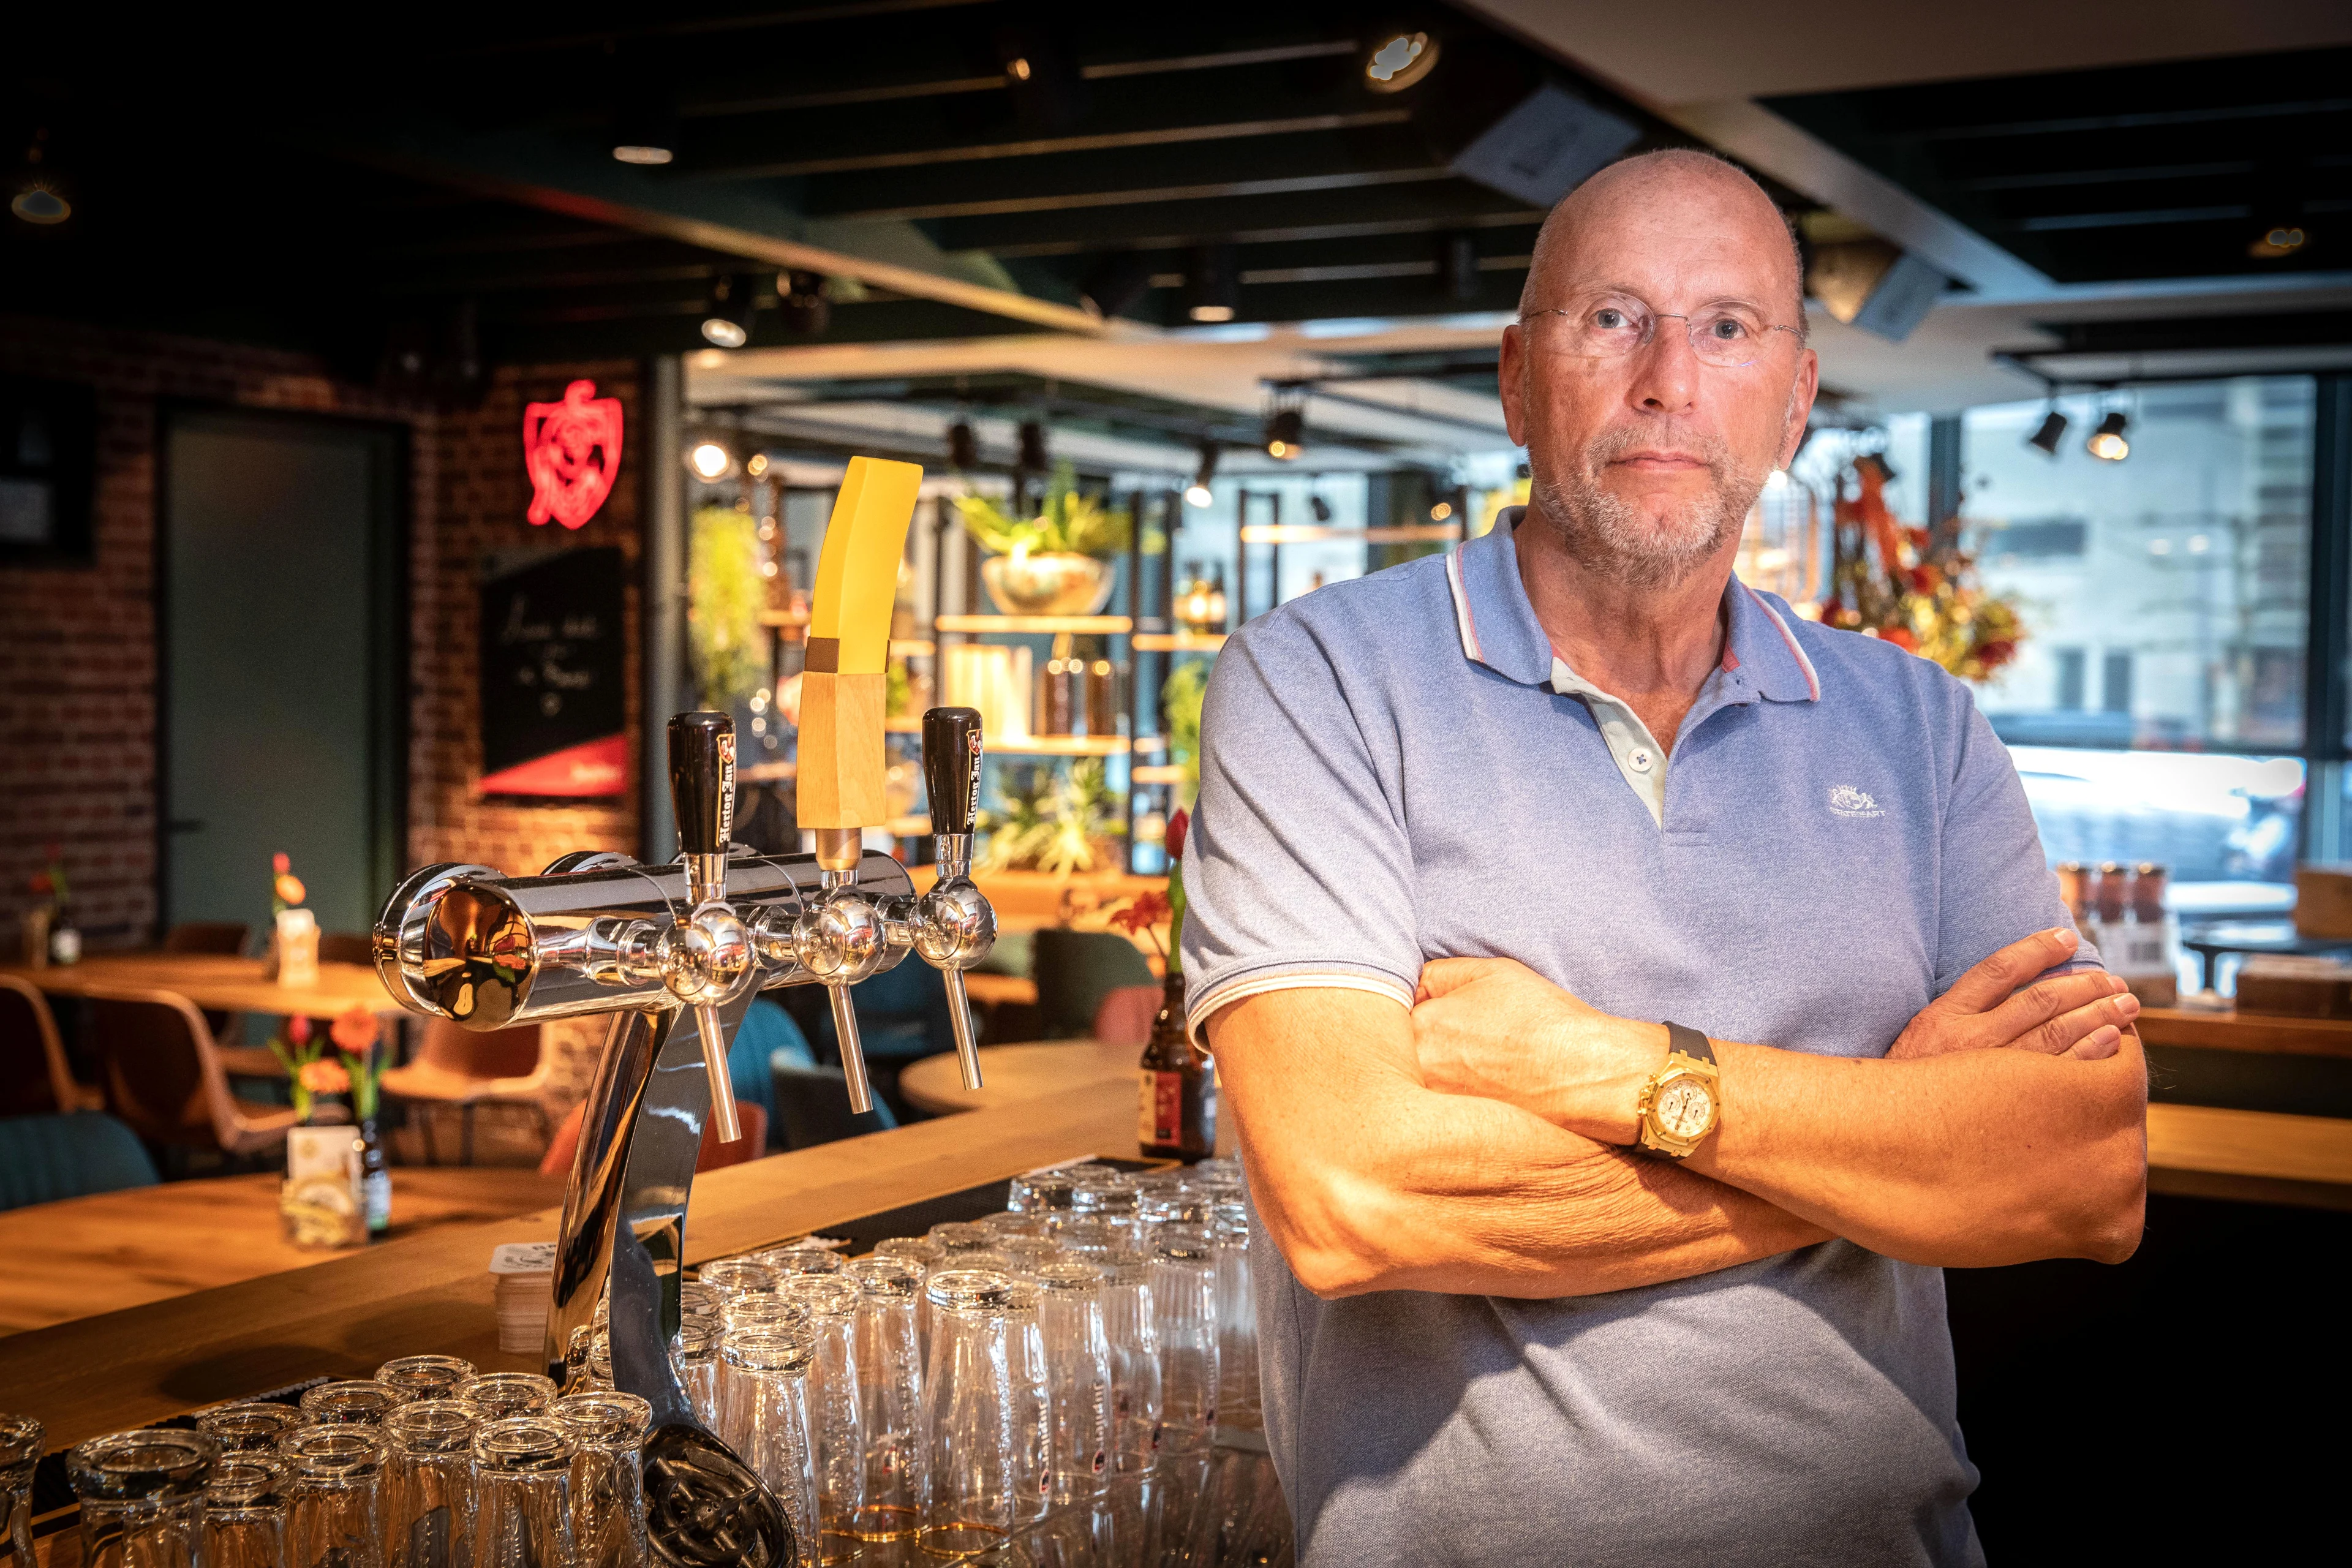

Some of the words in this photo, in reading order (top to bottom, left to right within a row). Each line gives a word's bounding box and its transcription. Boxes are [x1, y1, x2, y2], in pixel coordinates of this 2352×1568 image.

[722, 764, 734, 793] Jan
[971, 756, 981, 781] Jan
[719, 793, 733, 843] Hertog
[967, 782, 979, 825] Hertog
[1038, 1401, 1051, 1462] Jupiler
[1093, 1383, 1107, 1442] Jupiler
